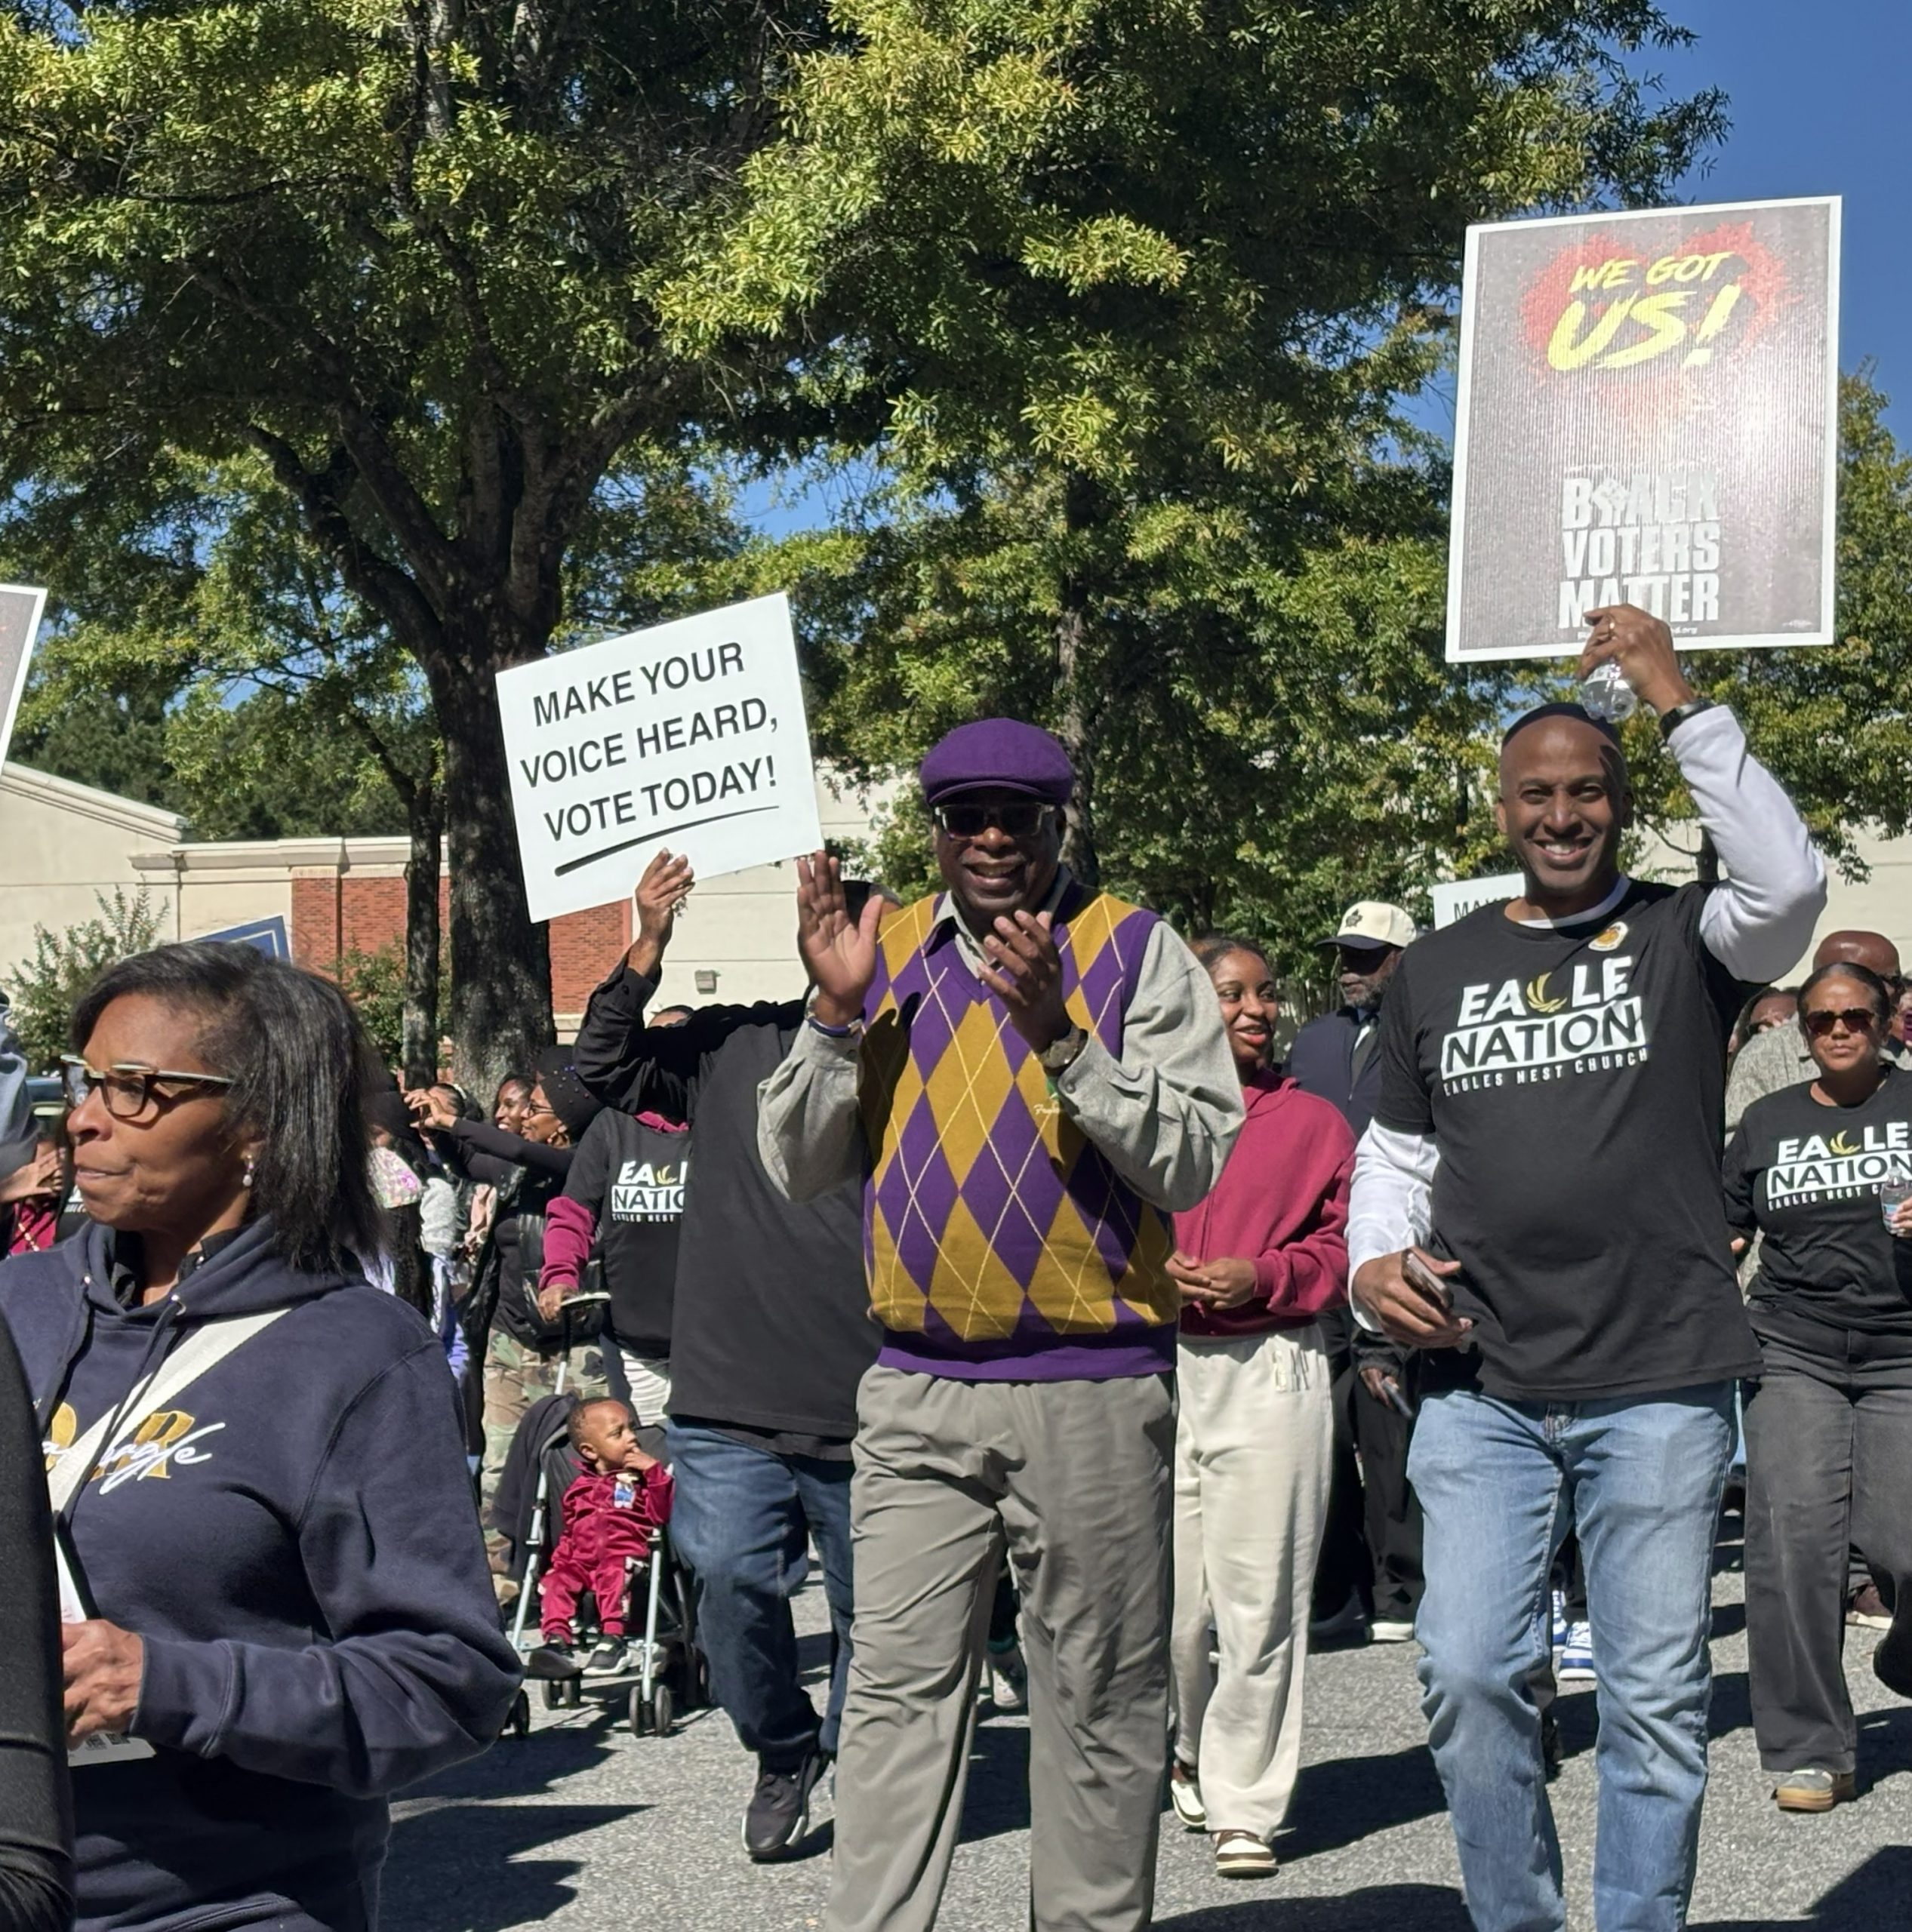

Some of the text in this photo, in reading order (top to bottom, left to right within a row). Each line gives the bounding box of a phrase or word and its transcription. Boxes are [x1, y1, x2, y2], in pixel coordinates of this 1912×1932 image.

[1569, 251, 1734, 293] WE GOT
[1547, 283, 1742, 371] US!
[1562, 522, 1720, 579] VOTERS
[533, 642, 744, 727] MAKE YOUR
[520, 698, 777, 788] VOICE HEARD,
[543, 755, 777, 841] VOTE TODAY!
[1443, 1047, 1649, 1097] EAGLES NEST CHURCH
[1446, 1003, 1639, 1073] NATION
[1769, 1193, 1817, 1211] EAGLES
[1827, 1186, 1861, 1200] NEST
